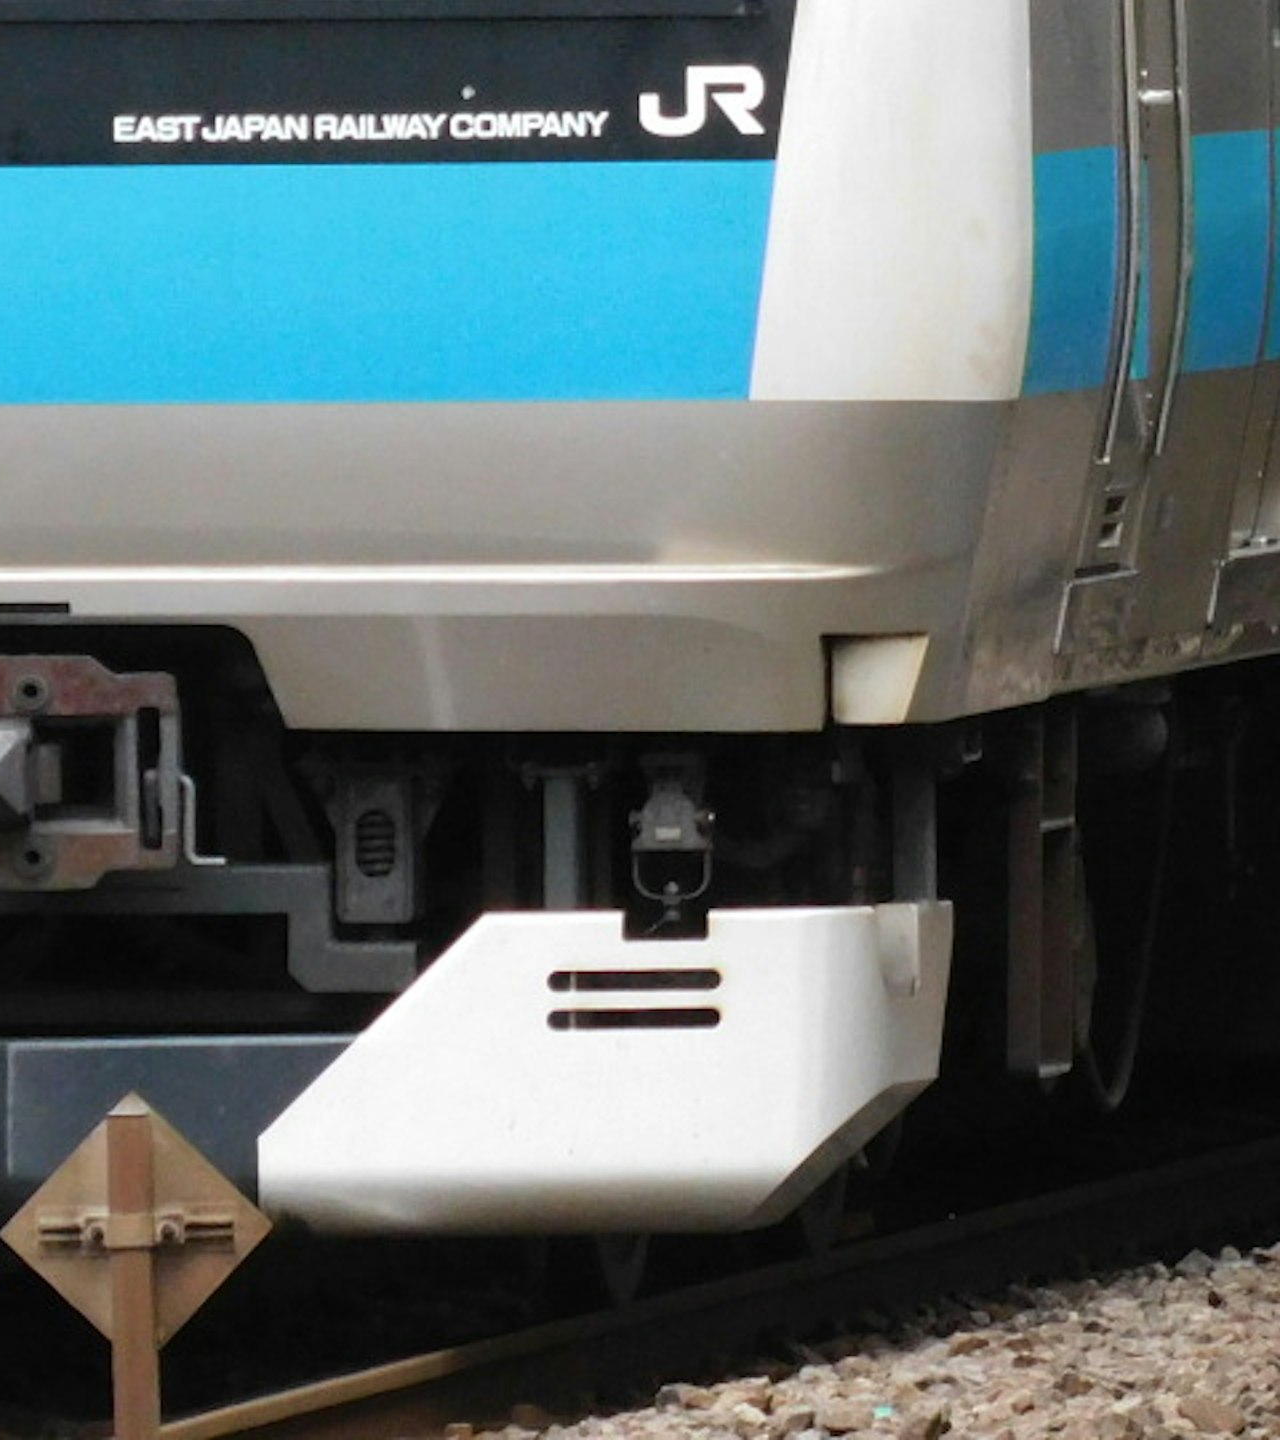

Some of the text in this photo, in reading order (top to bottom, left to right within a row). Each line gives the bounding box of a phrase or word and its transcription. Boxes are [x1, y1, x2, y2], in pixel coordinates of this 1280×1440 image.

[112, 110, 609, 143] EAST JAPAN RAILWAY COMPANY
[638, 63, 767, 138] JR
